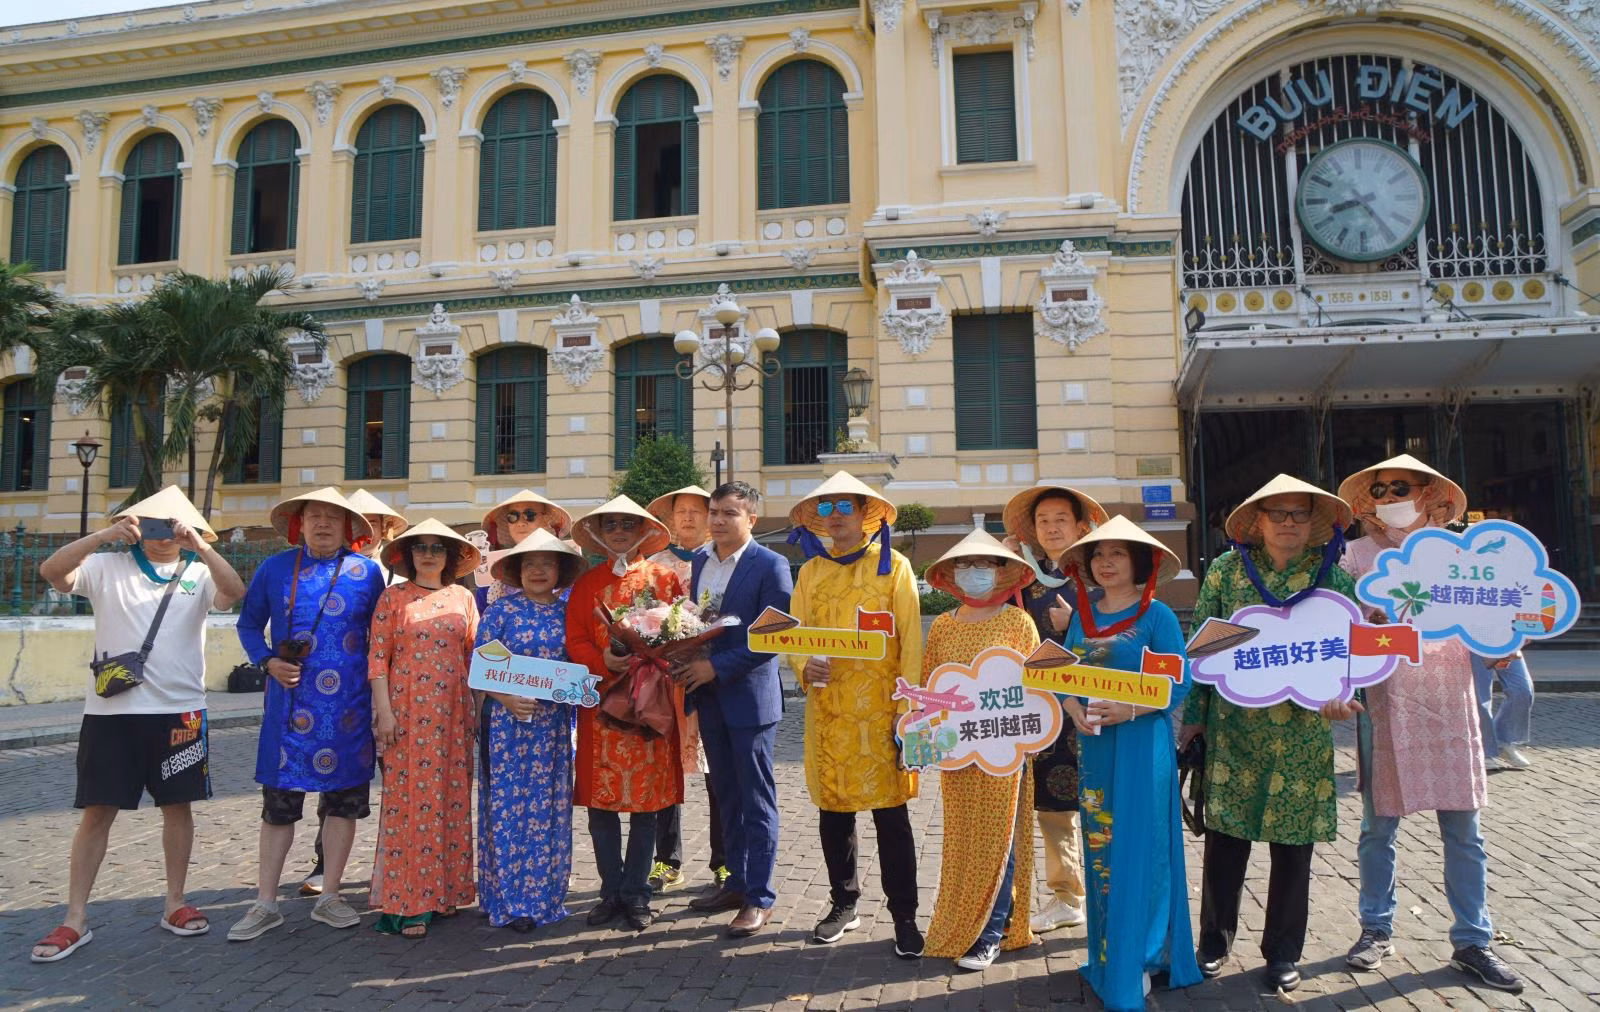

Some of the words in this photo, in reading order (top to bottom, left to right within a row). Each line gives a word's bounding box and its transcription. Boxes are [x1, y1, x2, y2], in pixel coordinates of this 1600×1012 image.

[1448, 564, 1495, 581] 3.16
[1430, 584, 1522, 608] 越南越美
[808, 637, 869, 650] VIETNAM
[1233, 637, 1348, 671] 越南好美
[485, 669, 554, 690] 我们爱越南
[1092, 677, 1159, 698] VIETNAM
[979, 686, 1024, 711] 欢迎
[959, 713, 1041, 742] 来到越南
